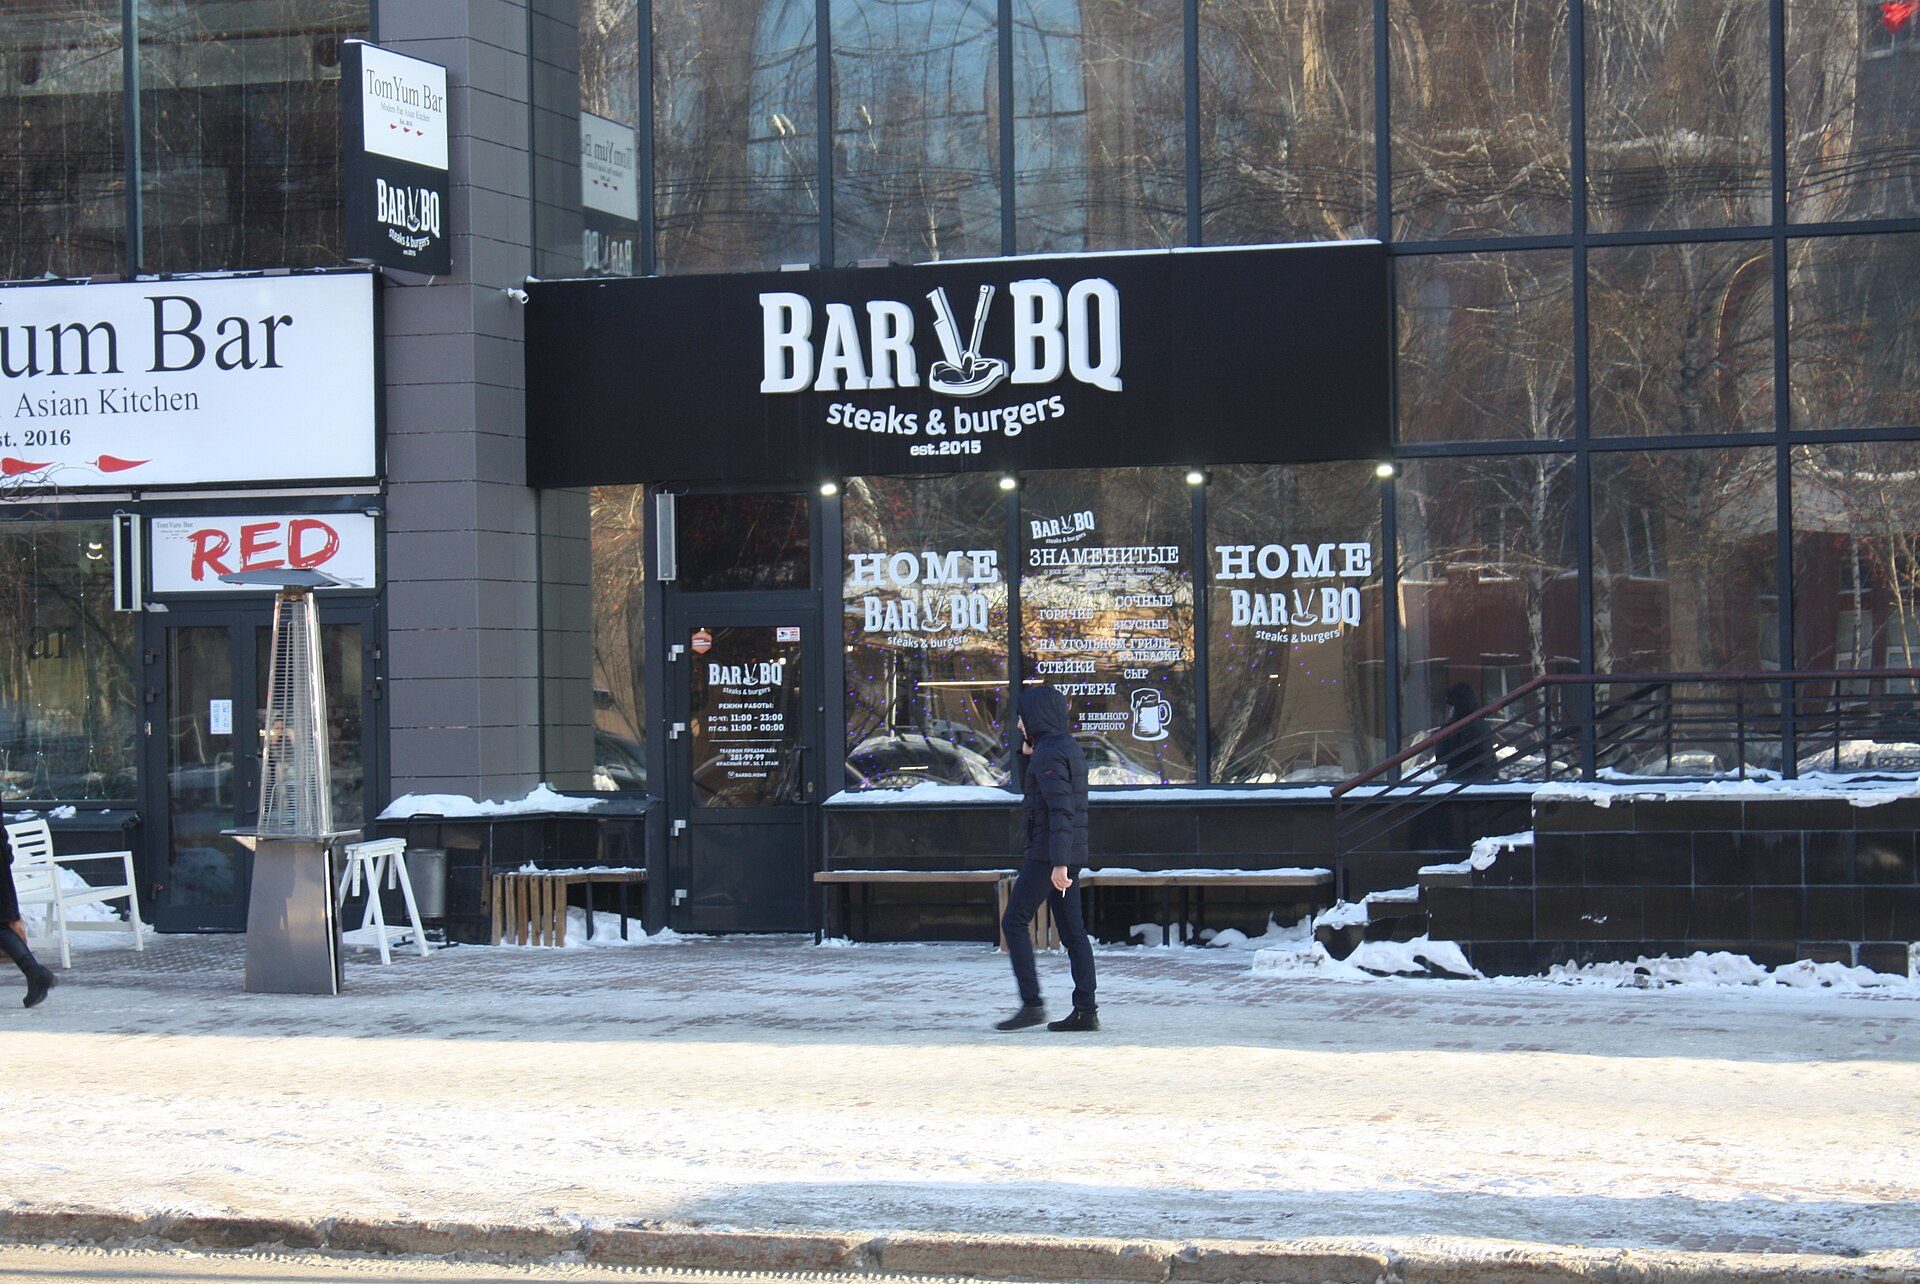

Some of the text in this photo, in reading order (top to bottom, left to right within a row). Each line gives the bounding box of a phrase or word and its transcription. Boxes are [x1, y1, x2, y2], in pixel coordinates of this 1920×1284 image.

[423, 84, 443, 113] Bar
[376, 177, 441, 239] BAR BQ
[388, 228, 431, 252] steaks & burgers
[0, 294, 294, 379] um Bar
[759, 277, 1124, 393] BAR BQ
[14, 385, 201, 418] Asian Kitchen
[826, 394, 1066, 437] steaks & burgers
[24, 429, 72, 447] 2016
[910, 439, 982, 457] est.2015
[1030, 510, 1096, 540] BAR BQ
[1066, 531, 1087, 542] burgers
[187, 518, 340, 583] RED
[1028, 545, 1179, 567] ЗНАМЕНИТЫЕ
[847, 549, 999, 587] HOME
[1214, 542, 1373, 580] HOME
[1115, 594, 1173, 608] СОЧНЫЕ
[1230, 586, 1361, 627] BAR BQ
[863, 594, 989, 634] BAR BQ
[1039, 608, 1094, 620] ГОРЯЧИЕ
[1112, 618, 1169, 630] ВКУСНЫЕ
[887, 634, 969, 649] steaks & burgers
[1039, 637, 1171, 650] НА УГОЛЬНОМ ГРИЛЕ
[1255, 628, 1341, 644] steaks & burgers
[1118, 650, 1181, 662] КОЛБАСКИ
[708, 661, 783, 686] BAR BQ
[1037, 659, 1097, 674] СТЕЙКИ
[1123, 668, 1149, 679] СЫР
[722, 686, 742, 695] steaks
[748, 686, 771, 696] burgers
[718, 702, 743, 710] РЕЖИМ
[730, 713, 752, 722] 11:00
[760, 713, 783, 722] 23:00
[1078, 712, 1129, 721] И НЕМНОГО
[730, 723, 752, 732] 11:00
[760, 723, 785, 732] 00:00
[1081, 722, 1126, 731] ВКУСНОГО
[730, 753, 765, 761] 281-99-99
